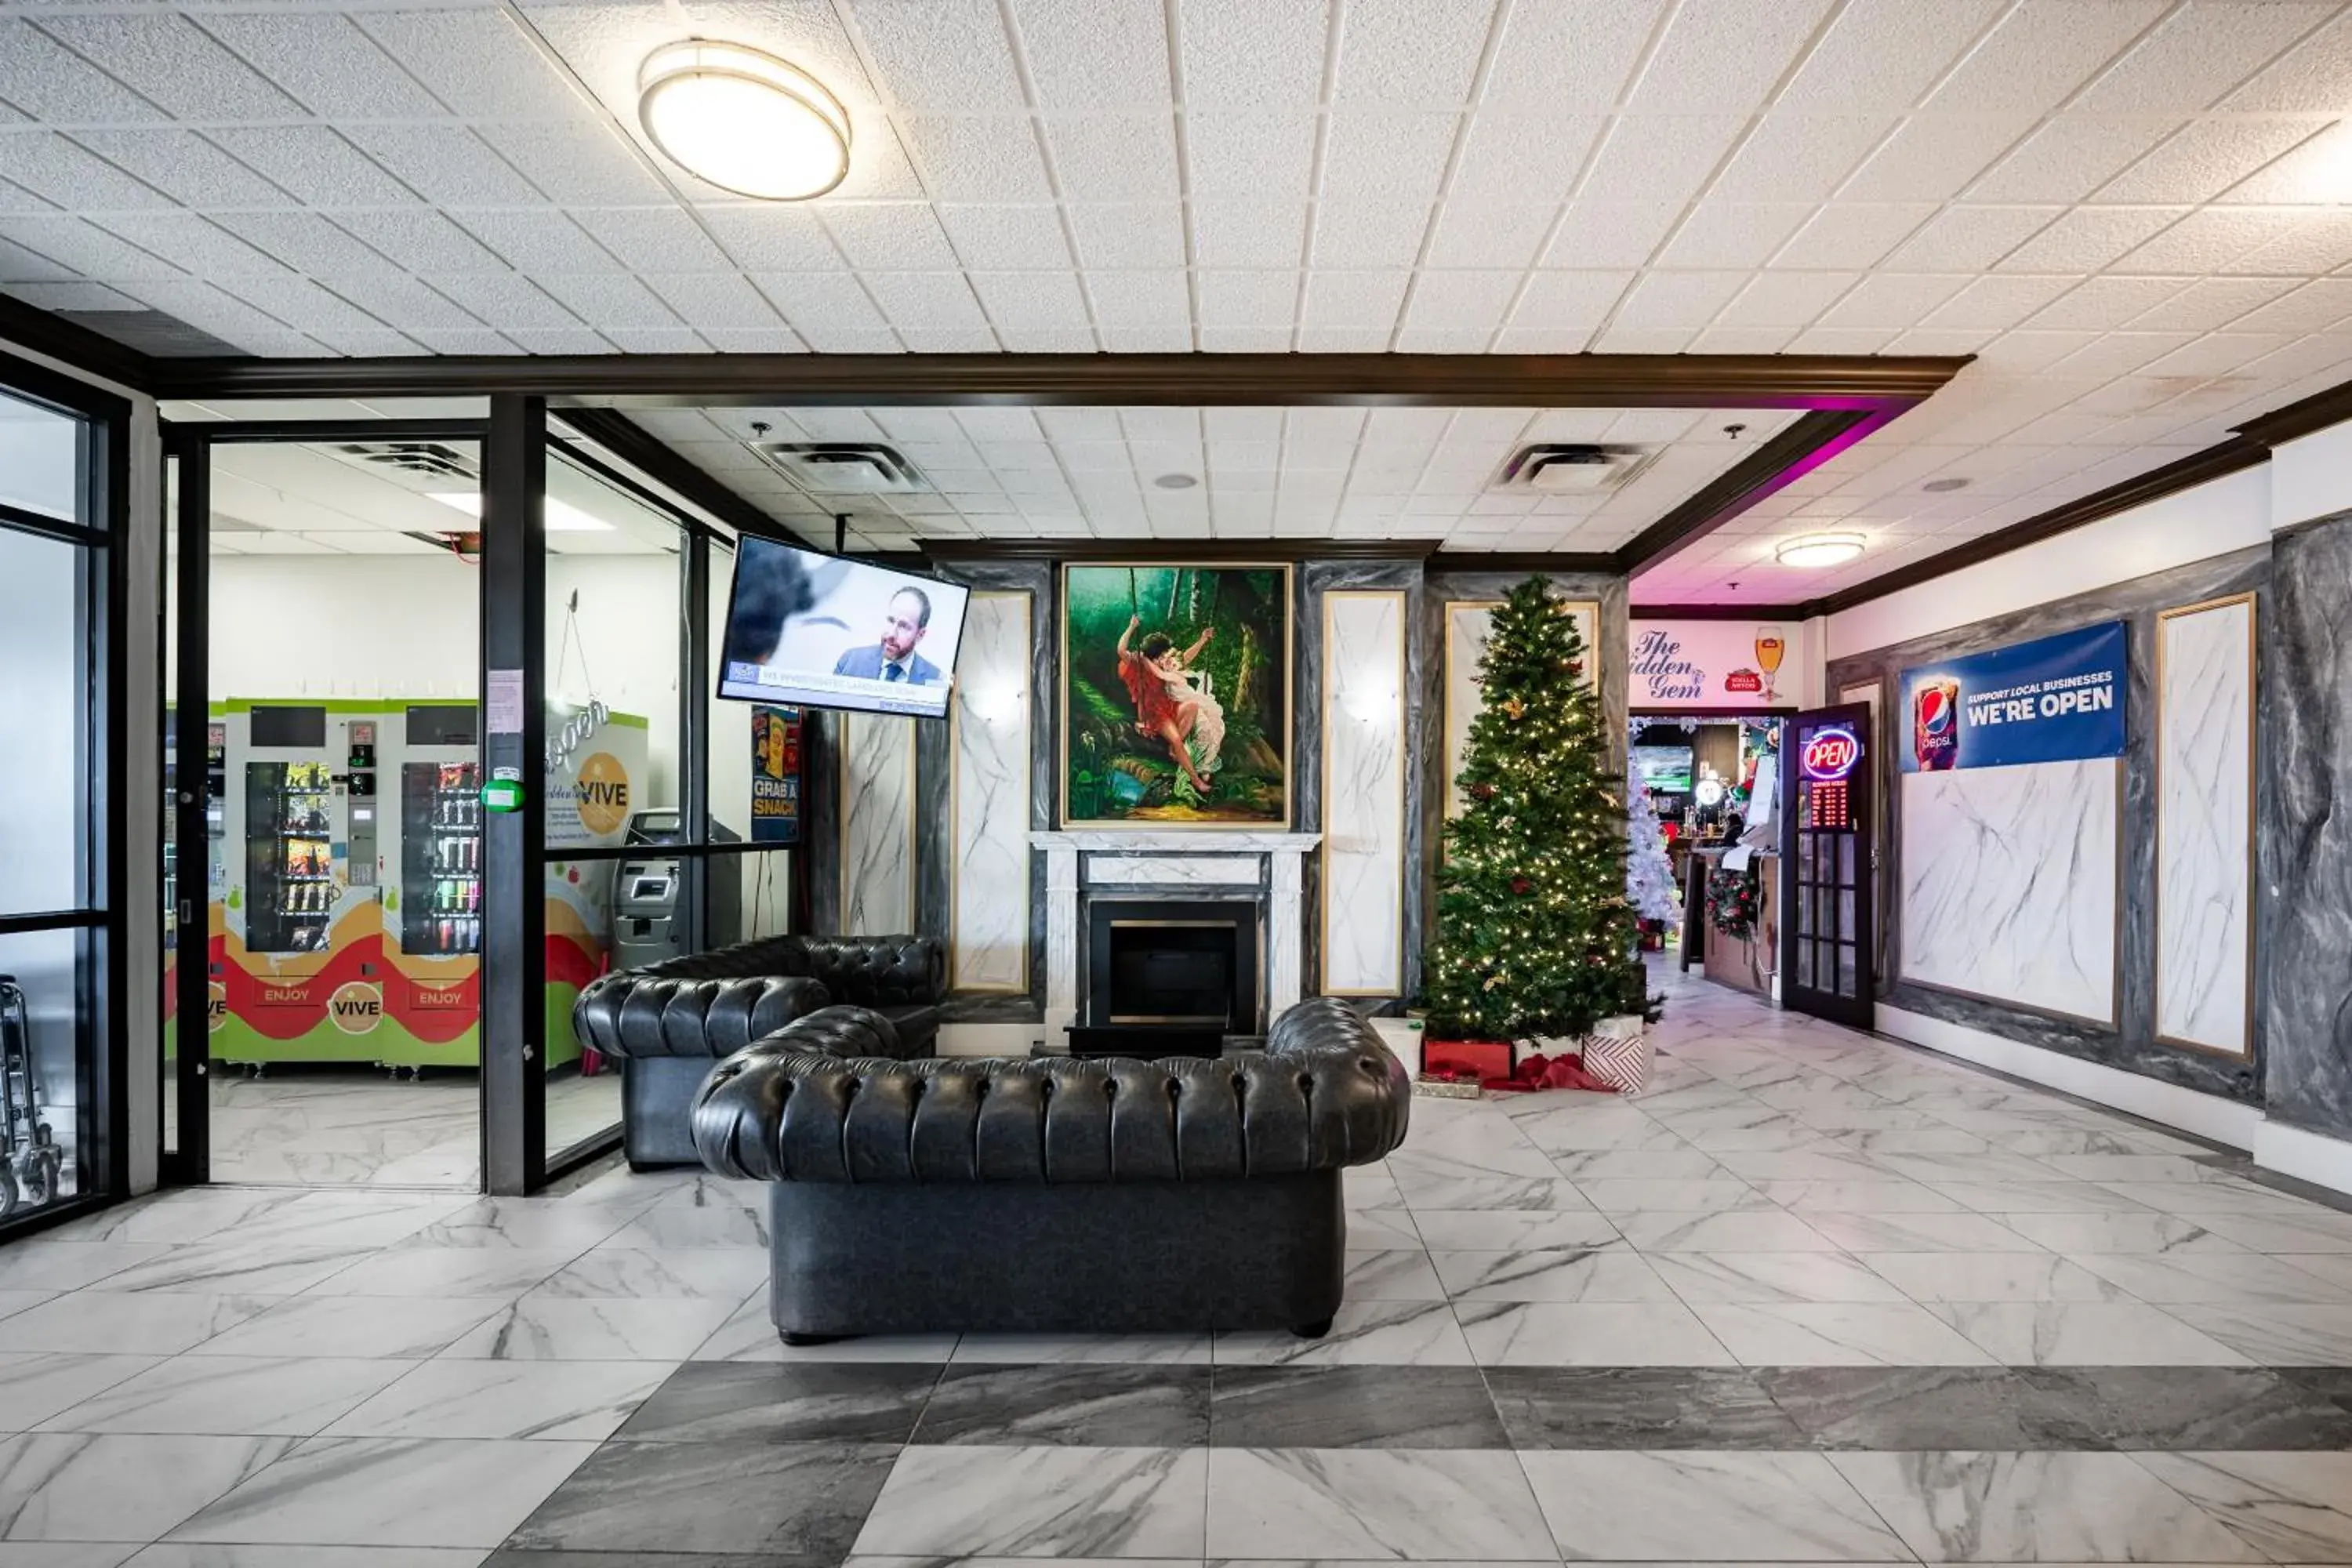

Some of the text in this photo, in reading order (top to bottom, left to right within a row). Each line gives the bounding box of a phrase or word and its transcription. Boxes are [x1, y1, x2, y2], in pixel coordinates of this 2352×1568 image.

[1637, 630, 1680, 655] The
[1630, 653, 1691, 674] idden
[1648, 673, 1700, 699] Gem
[1967, 670, 2113, 705] SUPPORT LOCAL BUSINESSES
[1967, 684, 2113, 727] WE'RE OPEN
[1807, 741, 1851, 768] OPEN
[579, 781, 627, 806] VIVE
[754, 780, 797, 799] GRAB A
[265, 989, 309, 1001] ENJOY
[419, 992, 462, 1004] ENJOY
[336, 1001, 379, 1015] VIVE
